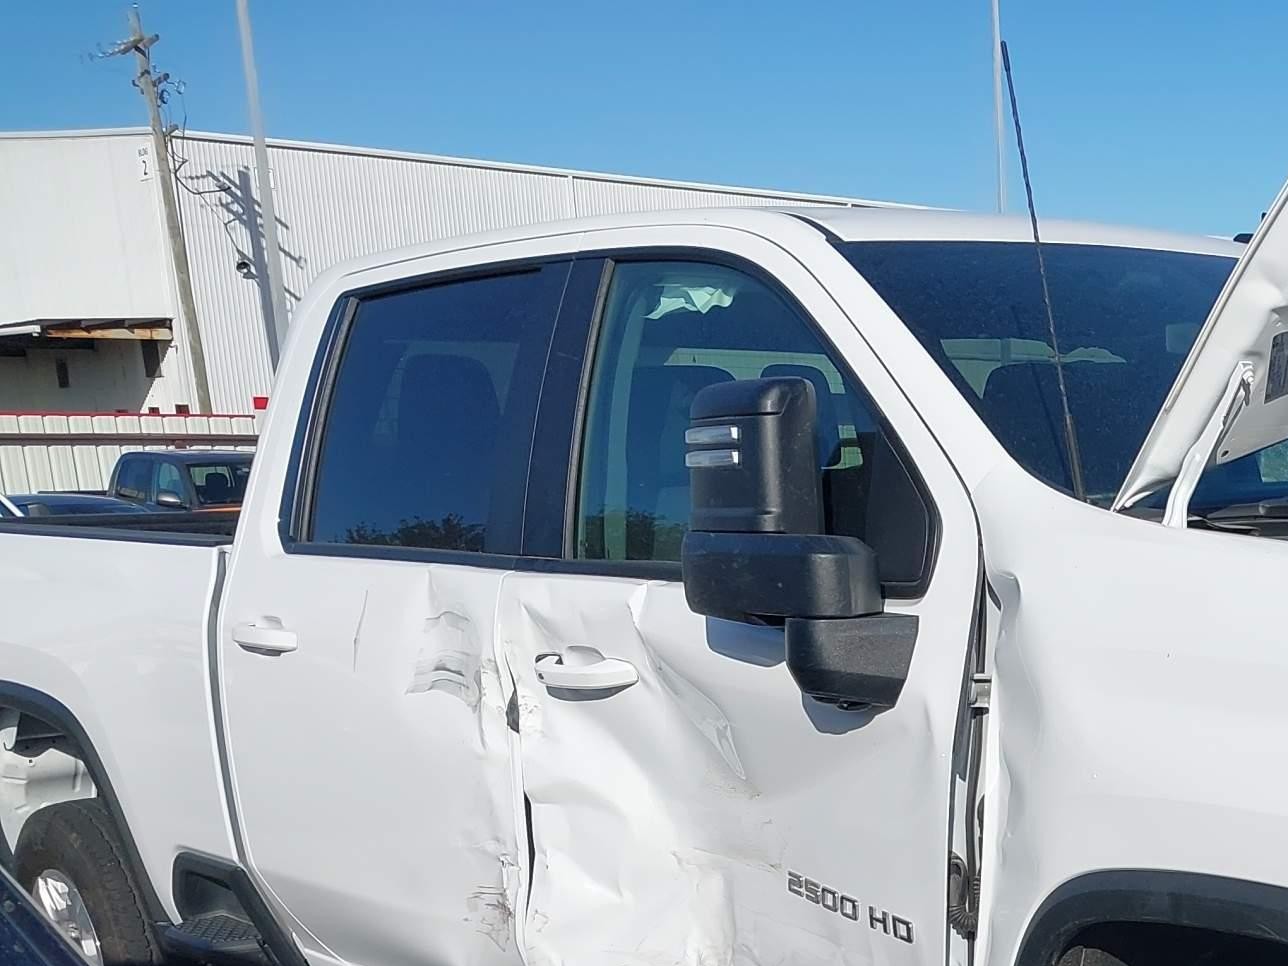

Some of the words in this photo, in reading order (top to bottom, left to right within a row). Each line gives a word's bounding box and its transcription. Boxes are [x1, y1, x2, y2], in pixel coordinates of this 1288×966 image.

[142, 160, 149, 176] 2
[787, 870, 860, 922] 2500
[868, 905, 915, 944] HD
